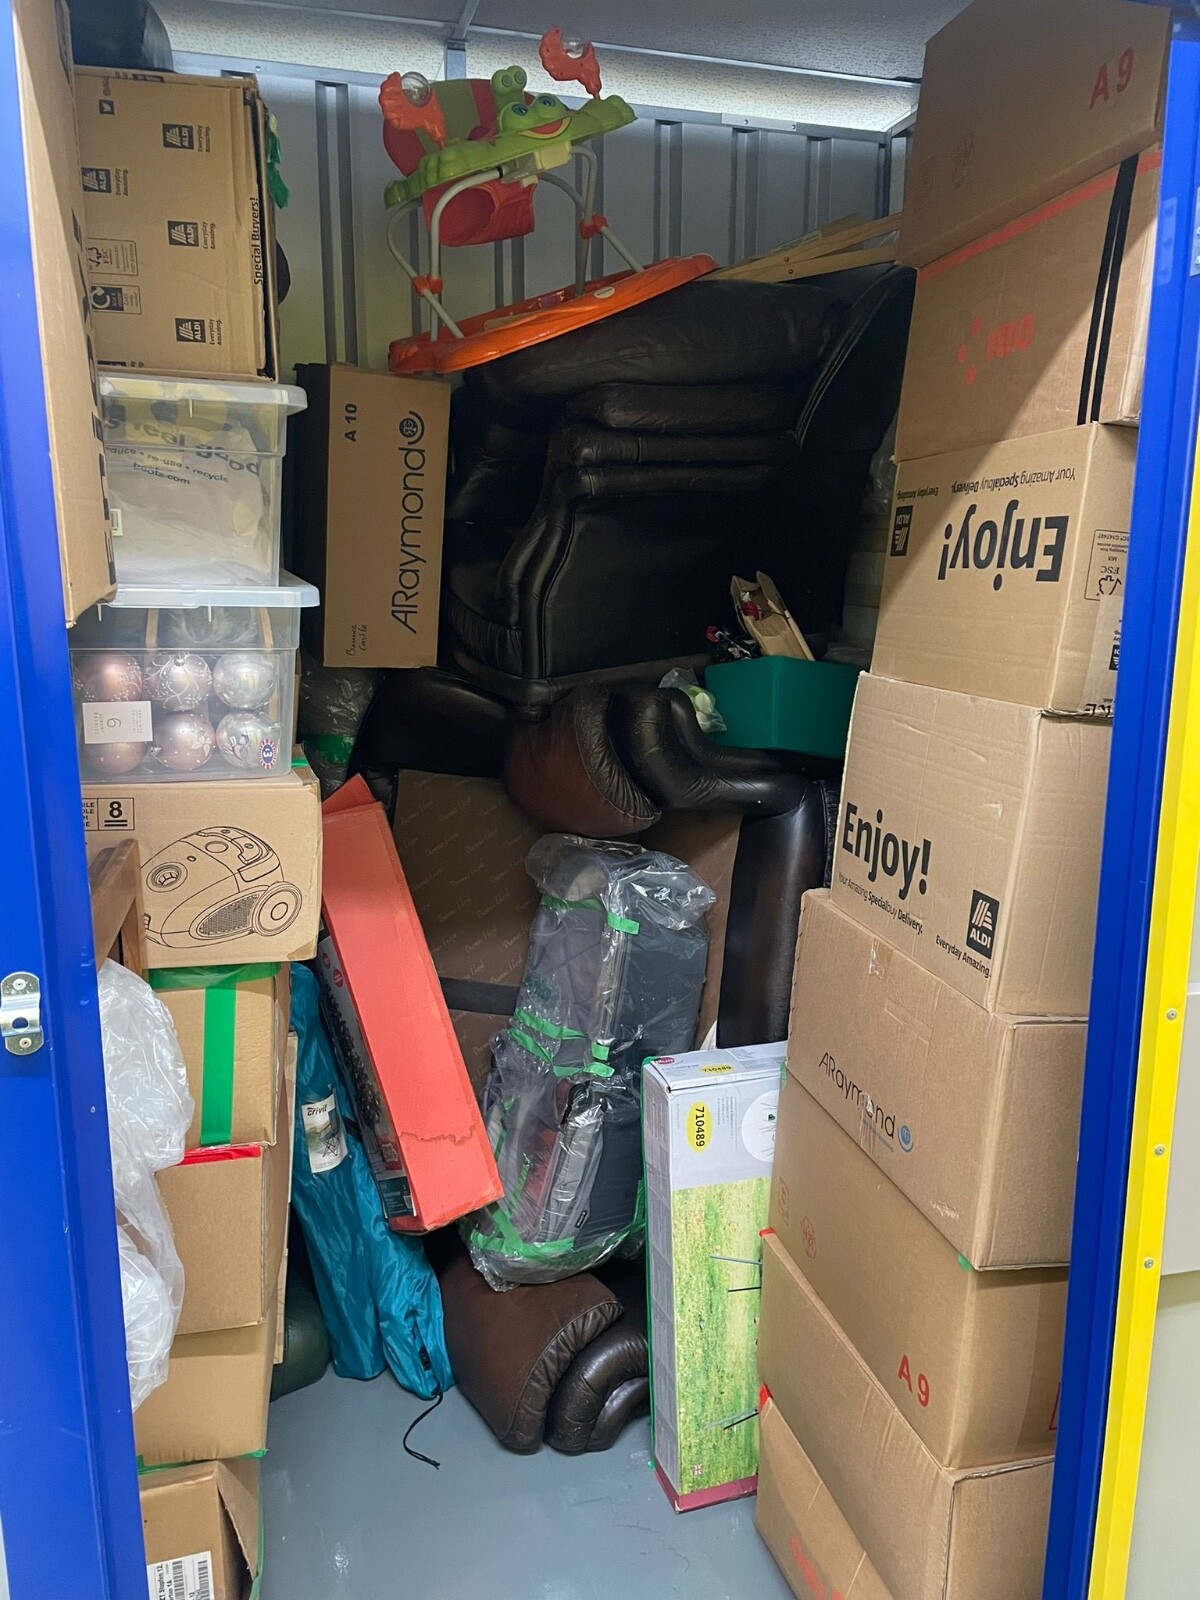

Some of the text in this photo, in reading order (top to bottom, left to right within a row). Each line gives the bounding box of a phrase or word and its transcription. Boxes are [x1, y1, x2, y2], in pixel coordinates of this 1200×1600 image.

[194, 321, 202, 341] ALDI
[1020, 469, 1055, 487] Amazing
[1056, 467, 1076, 481] Your
[391, 447, 426, 634] ARaymond
[937, 498, 1070, 592] Enjoy!
[1100, 565, 1121, 575] FSC
[109, 800, 123, 818] 8
[842, 802, 932, 901] Enjoy!
[848, 878, 868, 902] Amazing
[935, 934, 963, 961] Everyday
[969, 927, 992, 949] ALDI
[695, 1106, 706, 1148] 710489
